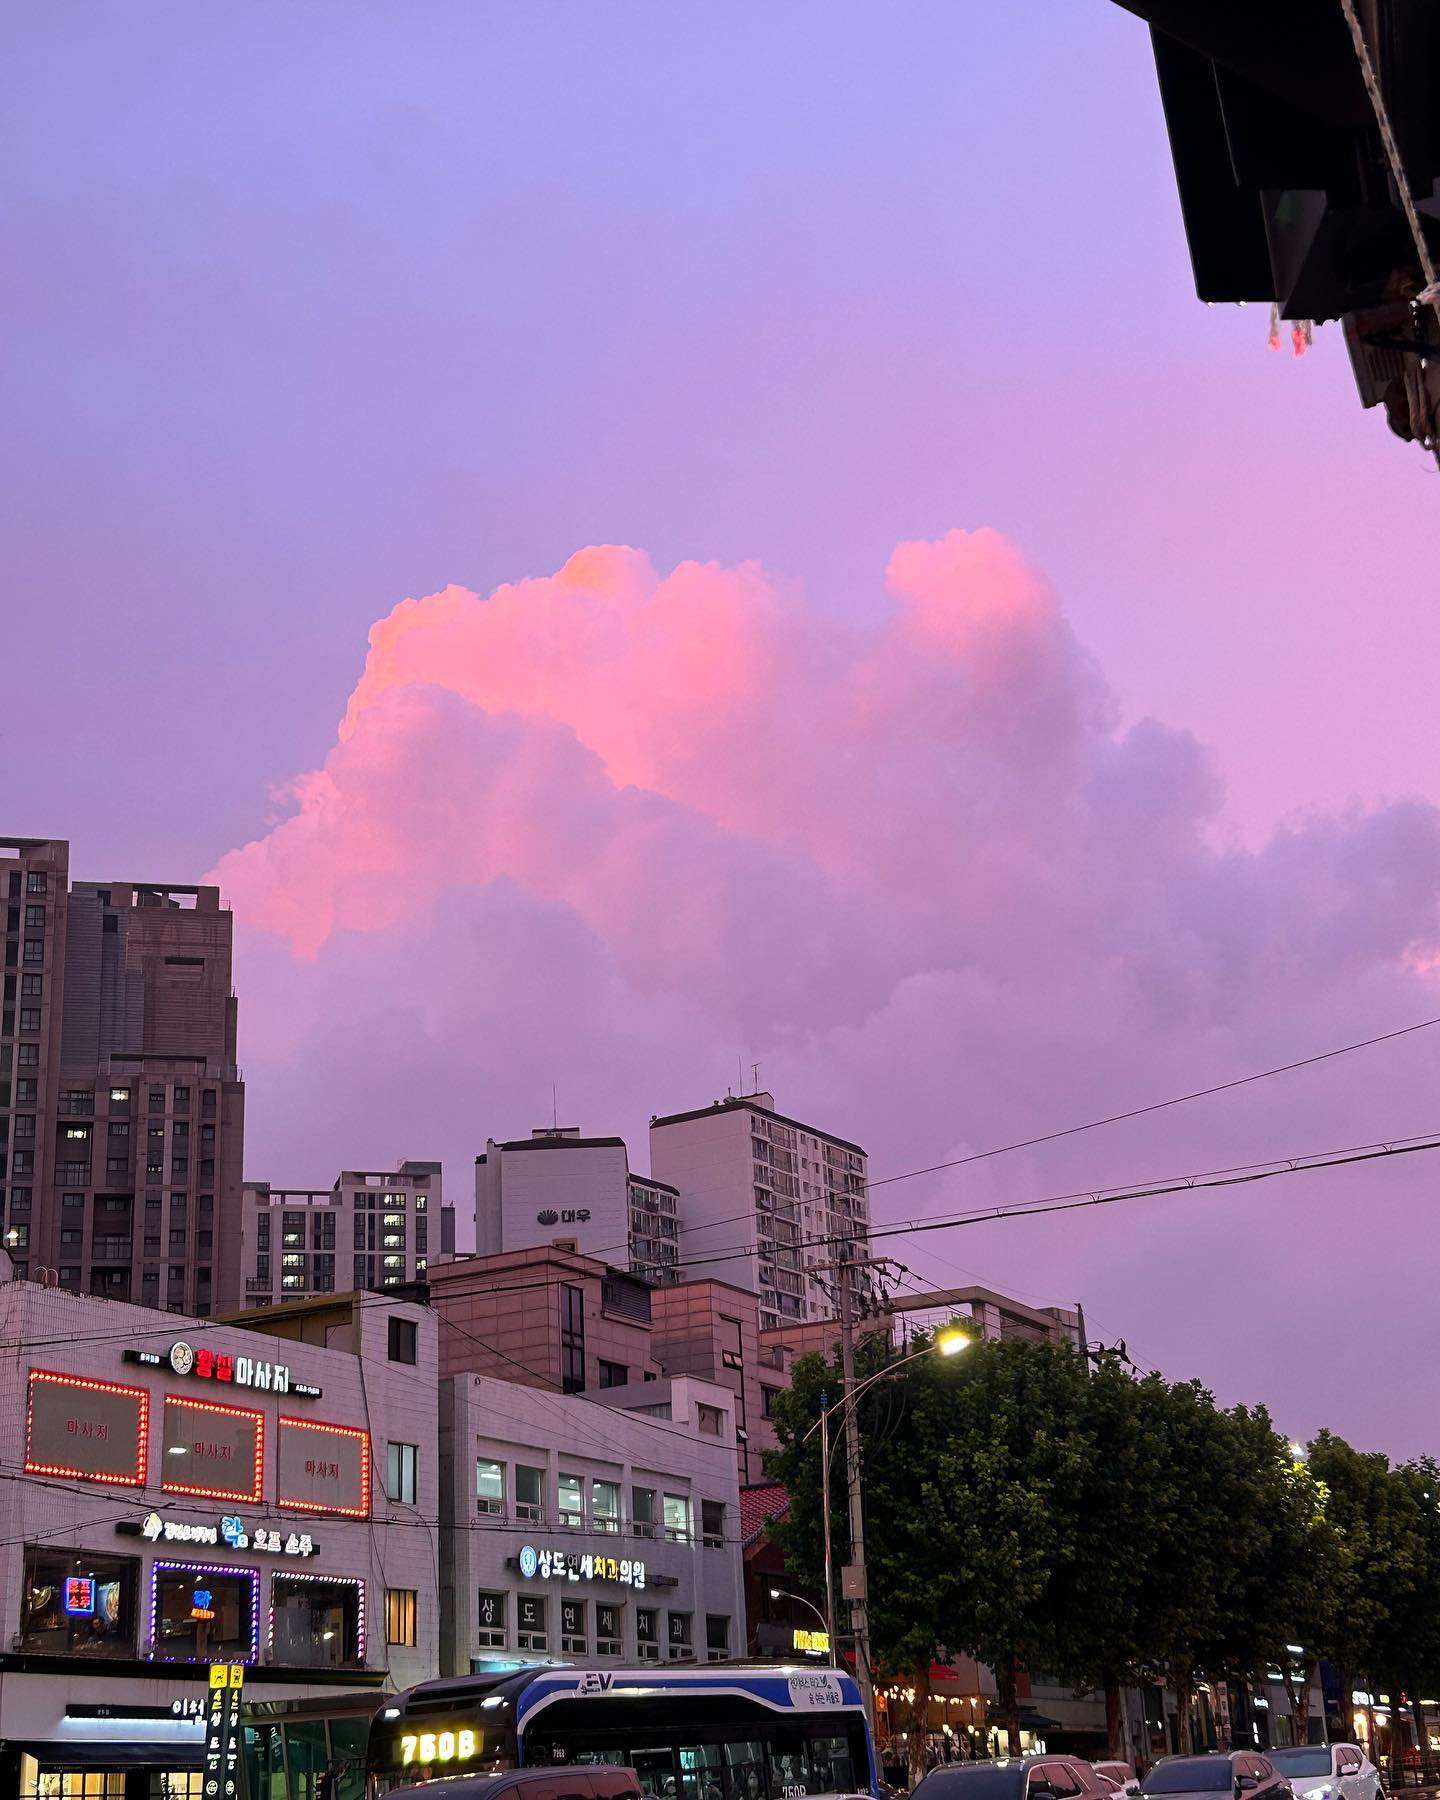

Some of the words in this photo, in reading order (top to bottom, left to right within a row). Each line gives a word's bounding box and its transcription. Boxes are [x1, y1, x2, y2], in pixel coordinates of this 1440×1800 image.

[561, 1209, 591, 1223] 대우
[236, 1357, 289, 1393] 마사지
[67, 1419, 109, 1441] 마사지
[194, 1442, 232, 1461] 마사지
[304, 1459, 340, 1479] 마사지
[253, 1528, 282, 1552] 호프
[286, 1533, 313, 1557] 소주
[69, 1595, 90, 1609] 소주
[481, 1599, 495, 1624] 상
[523, 1603, 536, 1623] 도
[564, 1606, 575, 1630] 연
[602, 1610, 613, 1631] 세
[639, 1615, 649, 1633] 치
[673, 1618, 683, 1638] 과
[585, 1673, 612, 1692] EV
[213, 1689, 222, 1701] 4
